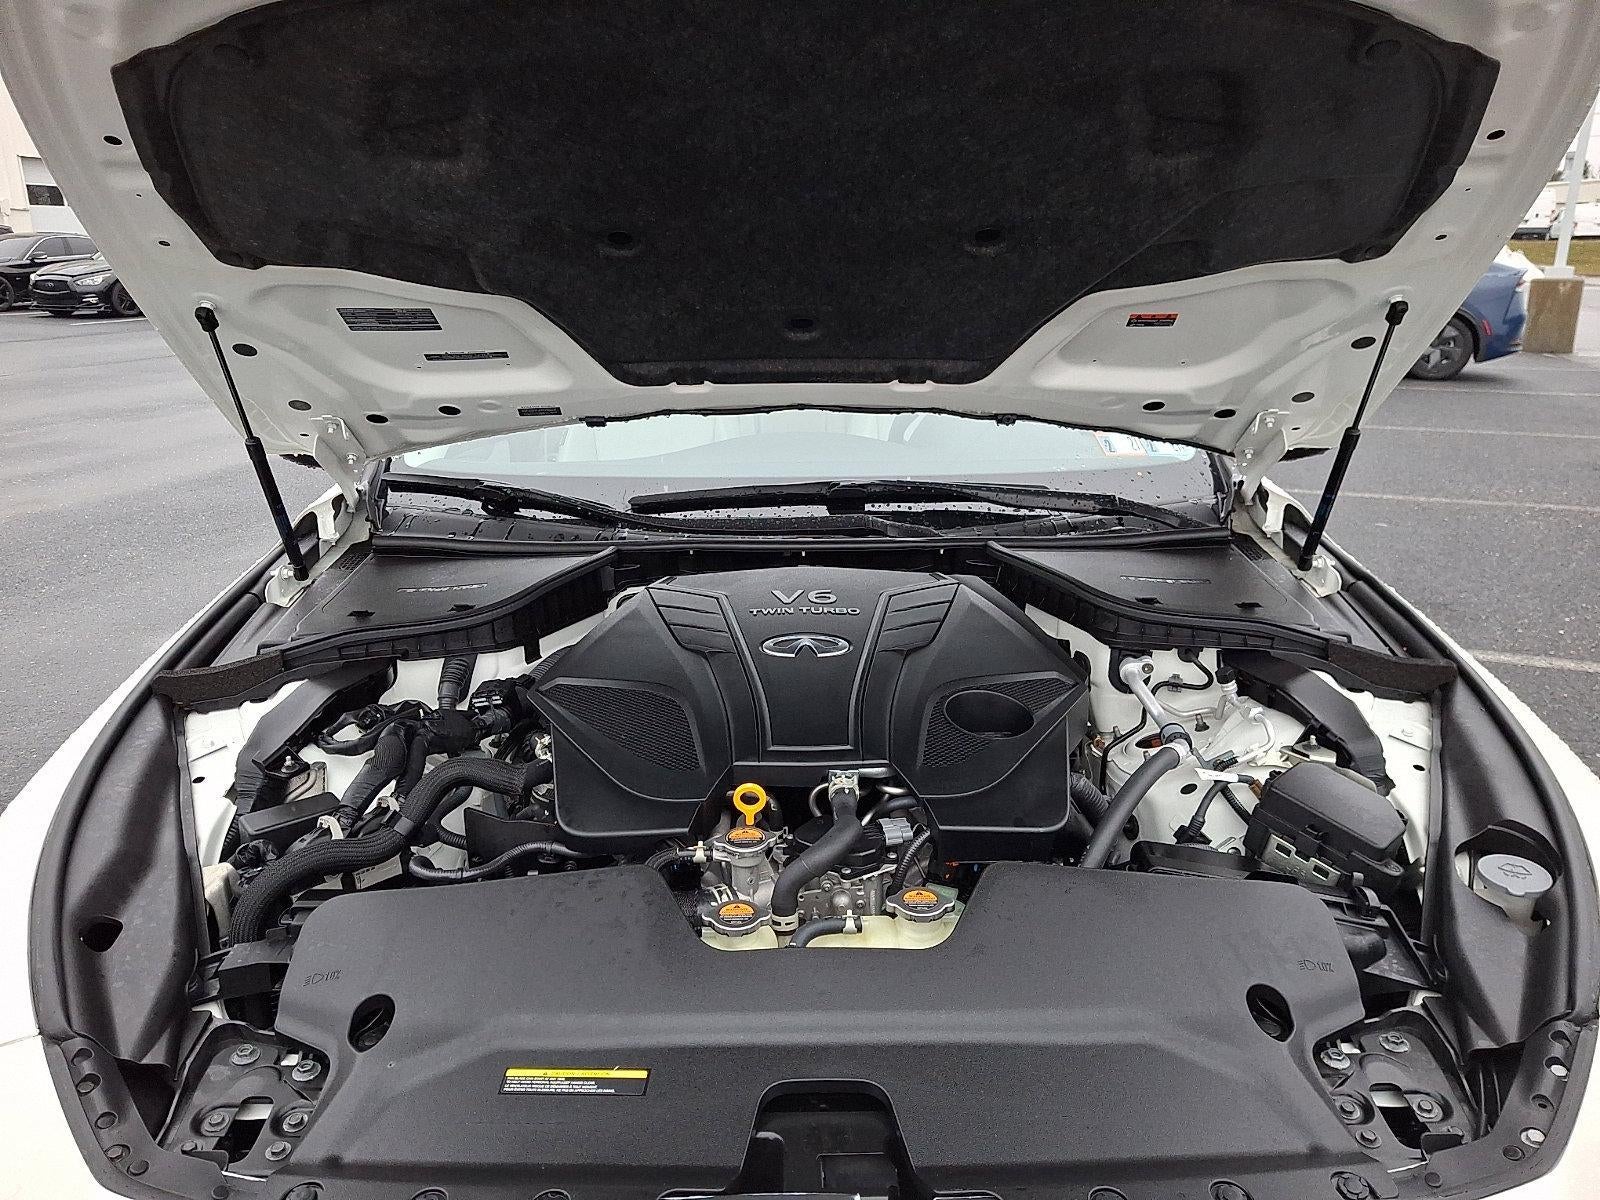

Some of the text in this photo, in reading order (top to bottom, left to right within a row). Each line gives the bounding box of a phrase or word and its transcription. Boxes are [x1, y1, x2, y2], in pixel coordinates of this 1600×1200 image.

[770, 588, 838, 605] V6
[749, 606, 861, 616] TWIN TURBO
